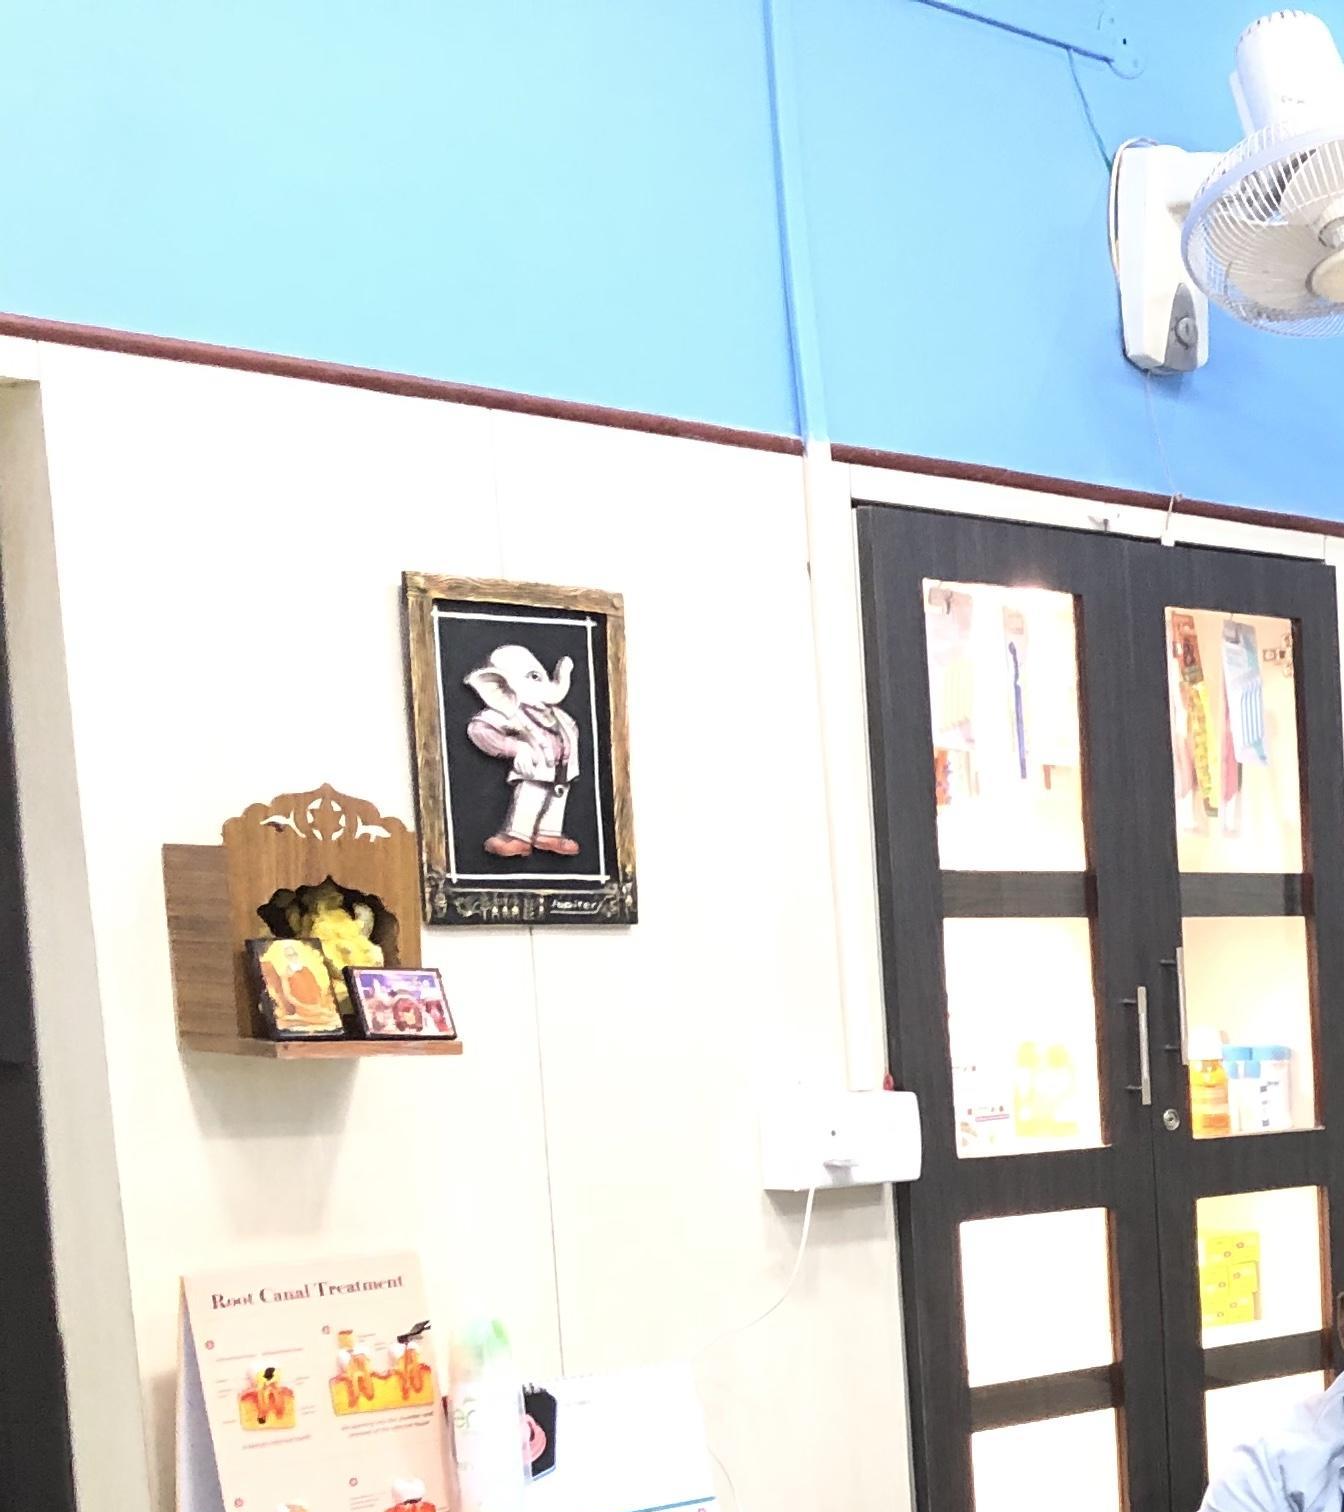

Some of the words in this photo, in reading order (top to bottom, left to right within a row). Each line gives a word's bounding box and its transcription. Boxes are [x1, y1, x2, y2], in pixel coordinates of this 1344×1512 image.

[212, 1292, 254, 1310] Root
[259, 1283, 311, 1303] Canal
[315, 1274, 405, 1297] Treatment
